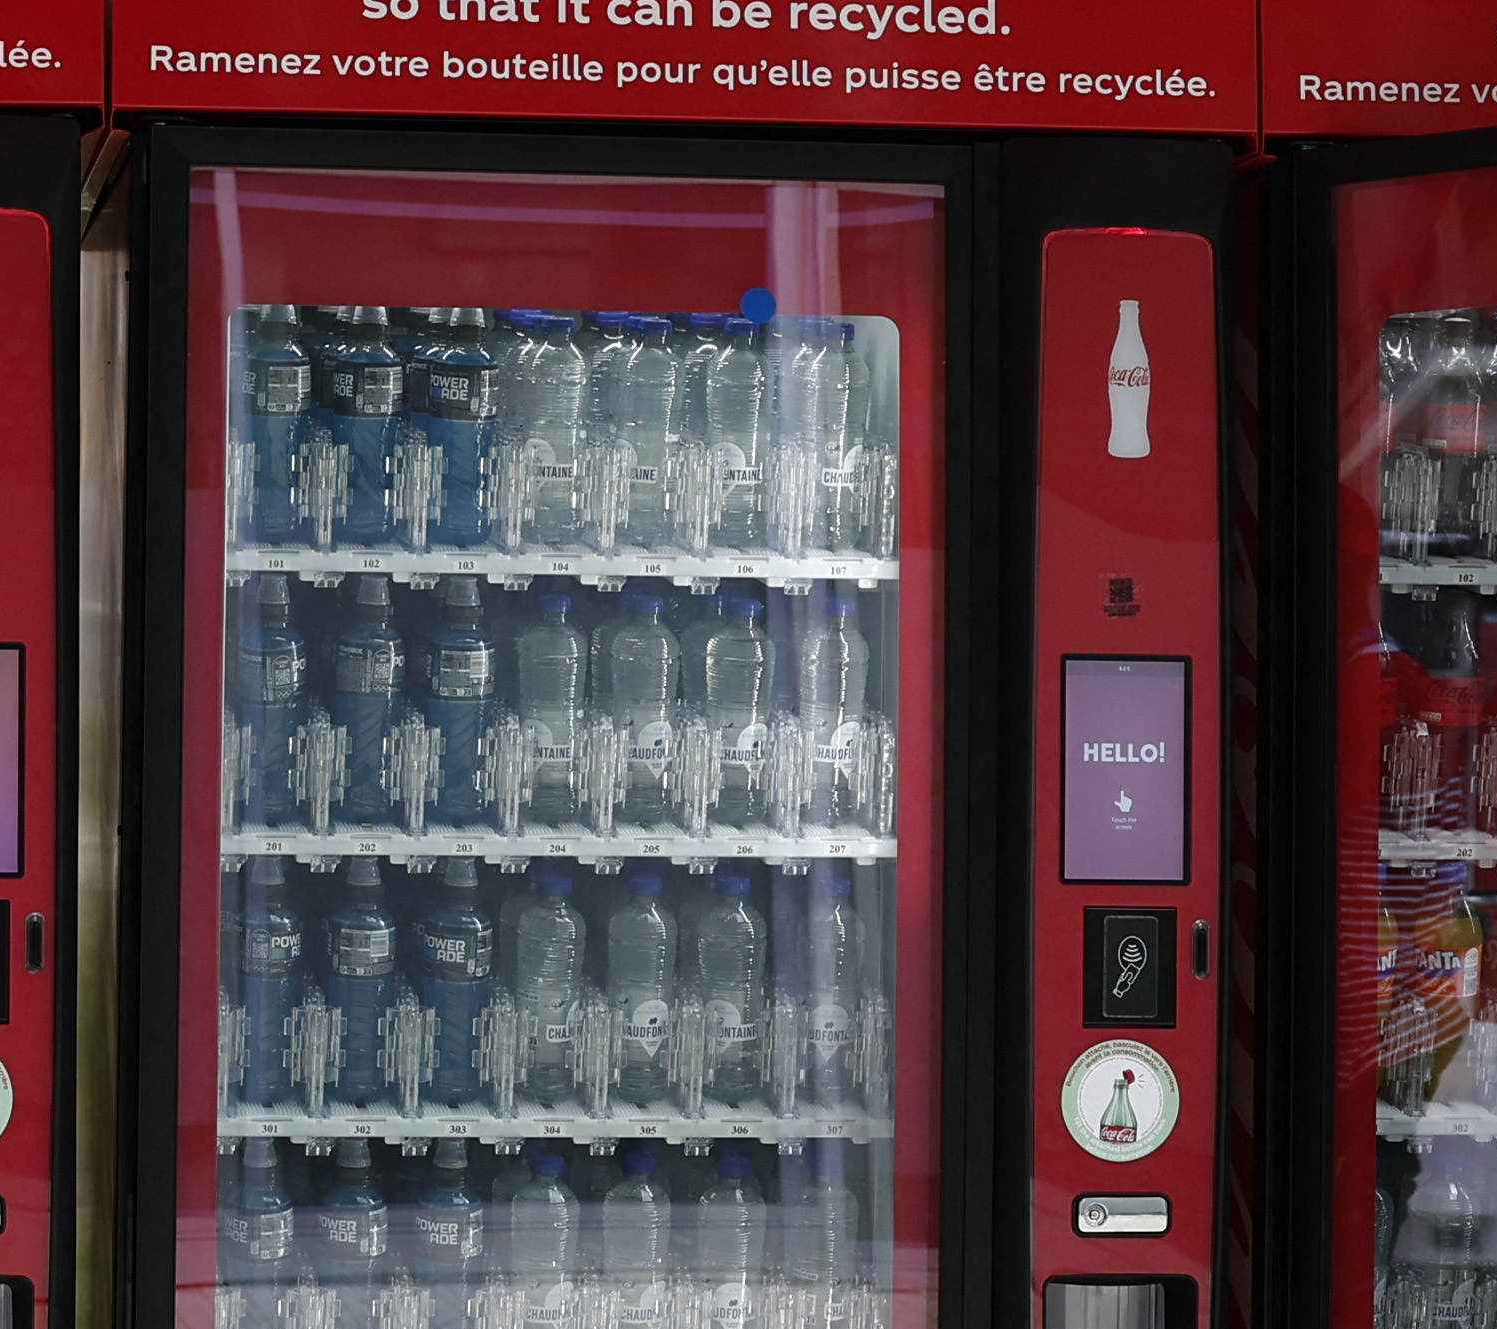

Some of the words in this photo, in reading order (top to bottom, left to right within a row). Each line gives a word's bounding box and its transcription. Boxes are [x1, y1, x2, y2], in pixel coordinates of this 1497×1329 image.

[150, 45, 321, 75] Ramenez
[332, 50, 430, 78] votre
[443, 50, 604, 82] bouteille
[617, 61, 701, 88] pour
[845, 61, 962, 94] puisse
[973, 63, 1046, 93] être
[1059, 68, 1216, 101] recyclée.
[1299, 74, 1461, 103] Ramenez
[1109, 364, 1150, 388] Coca-Cola
[440, 388, 469, 401] ADE
[457, 560, 475, 570] 103
[1083, 741, 1165, 763] HELLO!
[437, 950, 467, 963] ADE
[639, 1125, 657, 1136] 305
